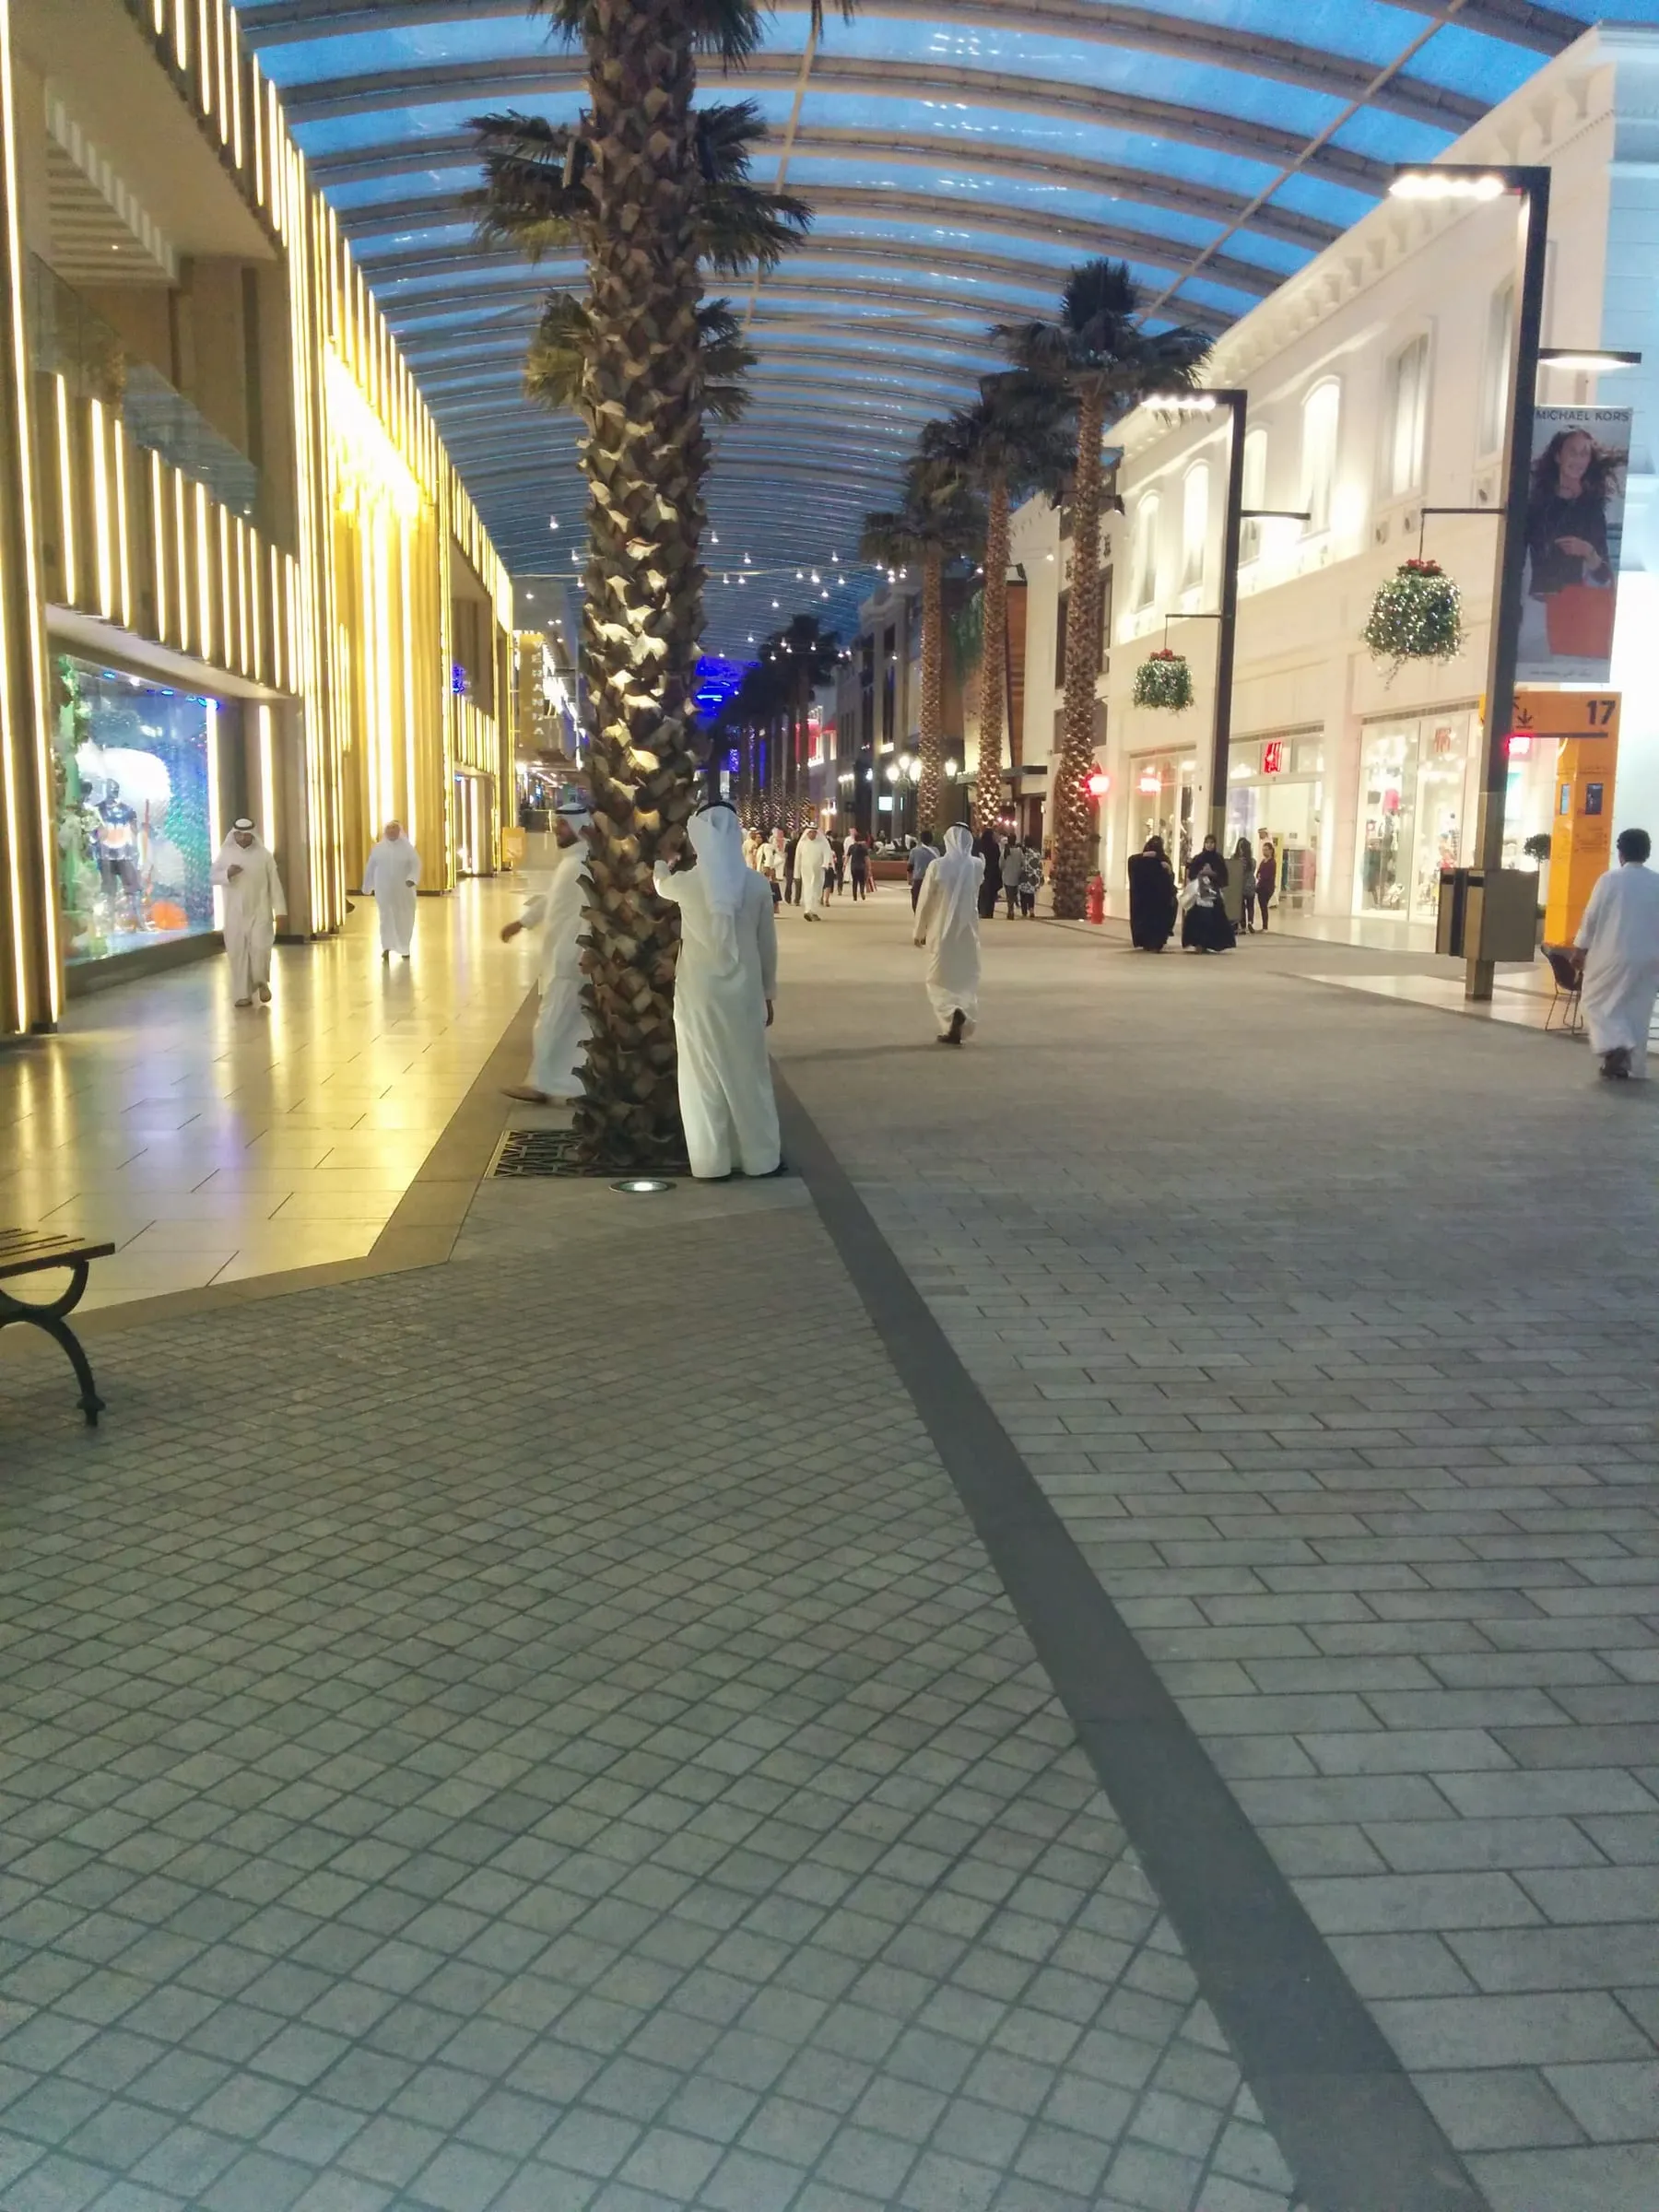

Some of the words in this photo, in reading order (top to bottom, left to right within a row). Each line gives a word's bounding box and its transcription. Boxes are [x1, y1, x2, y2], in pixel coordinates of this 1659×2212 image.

[1535, 409, 1591, 421] MICHAEL
[1594, 411, 1630, 422] KORS
[1586, 700, 1616, 725] 17
